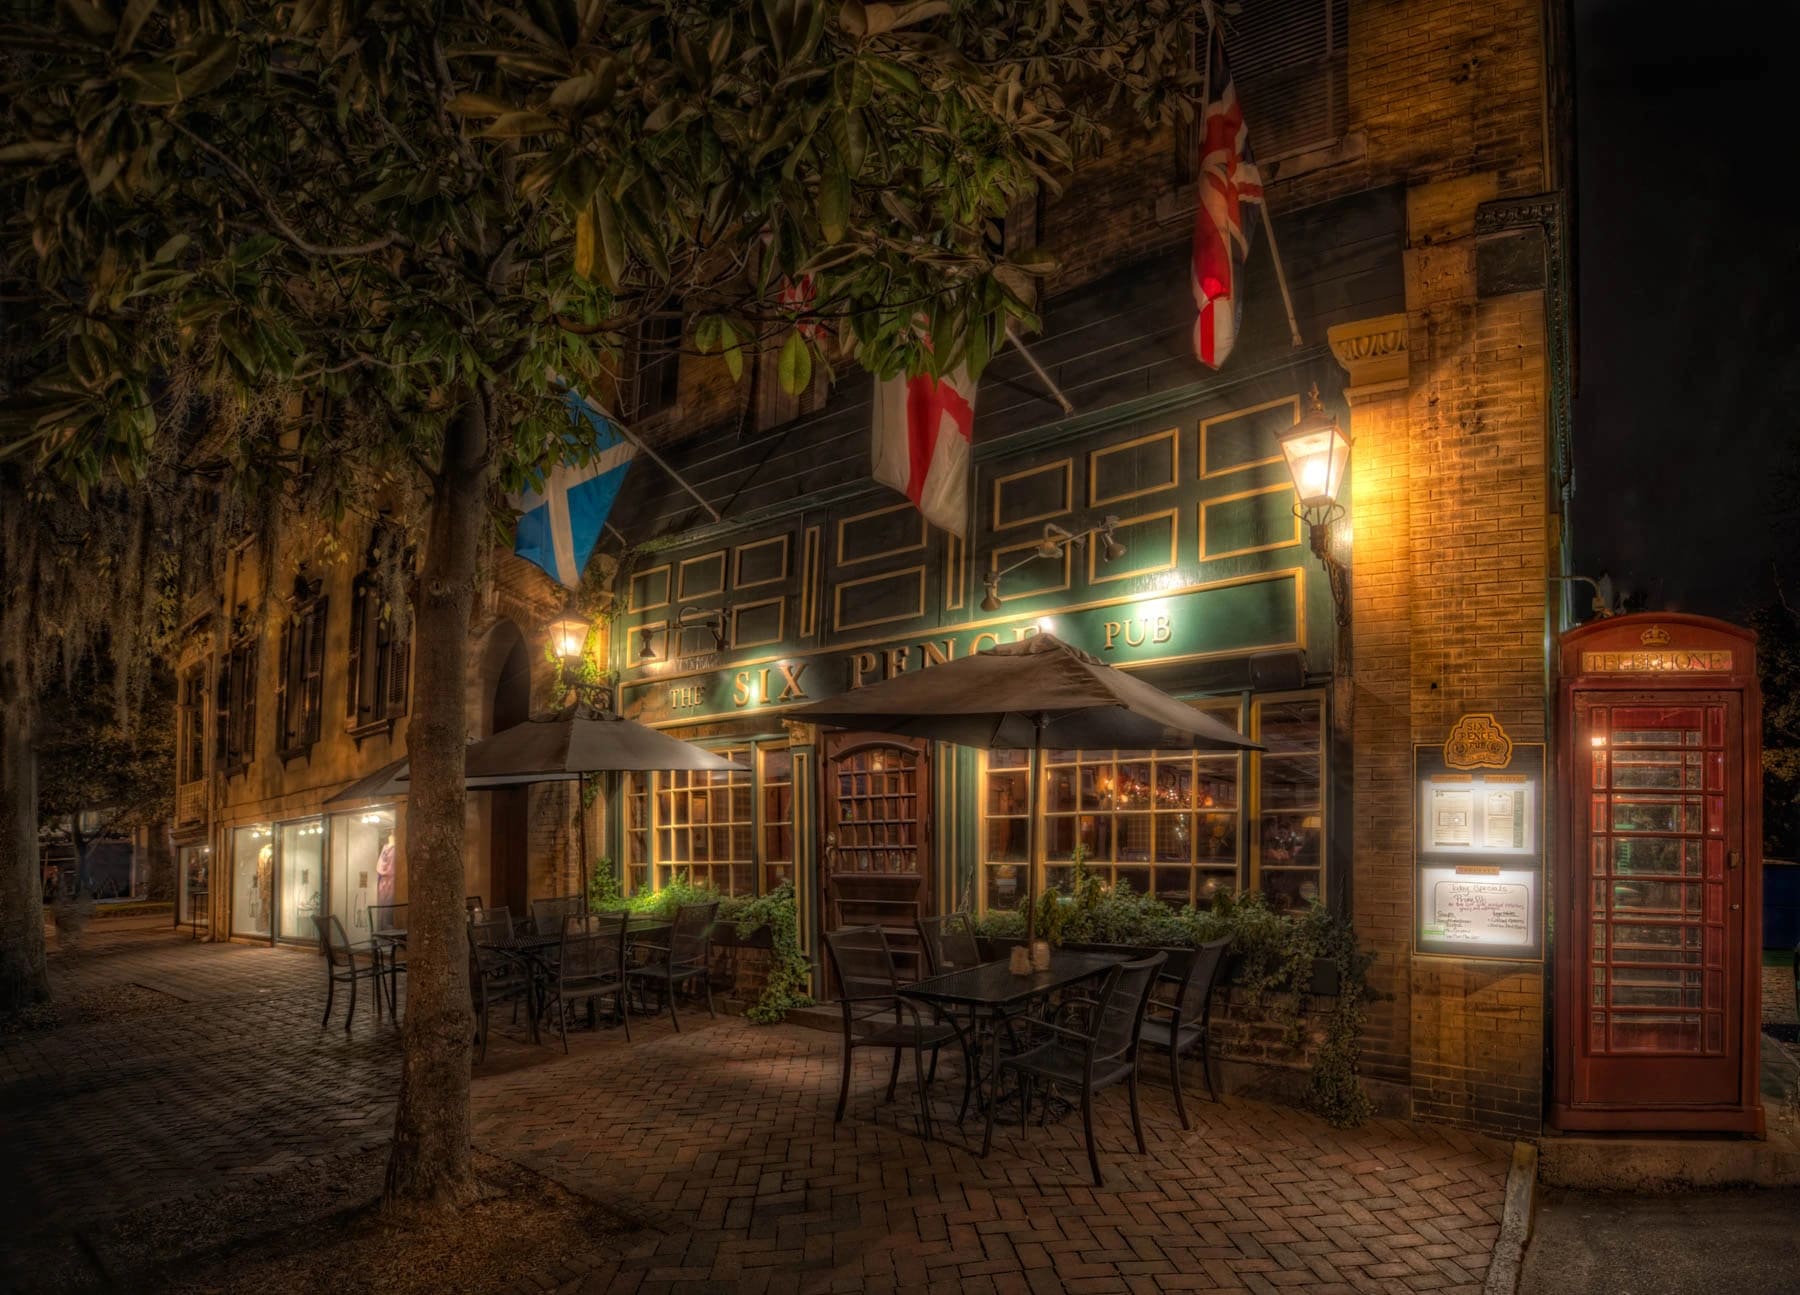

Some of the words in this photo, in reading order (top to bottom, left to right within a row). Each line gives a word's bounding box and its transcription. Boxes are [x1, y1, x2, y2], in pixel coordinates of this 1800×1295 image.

[670, 685, 705, 709] THE
[732, 662, 808, 707] SIX
[1103, 616, 1172, 651] PUB
[1588, 652, 1722, 671] TELEPHONE
[1467, 722, 1482, 731] SIX
[1459, 731, 1493, 741] PENCE
